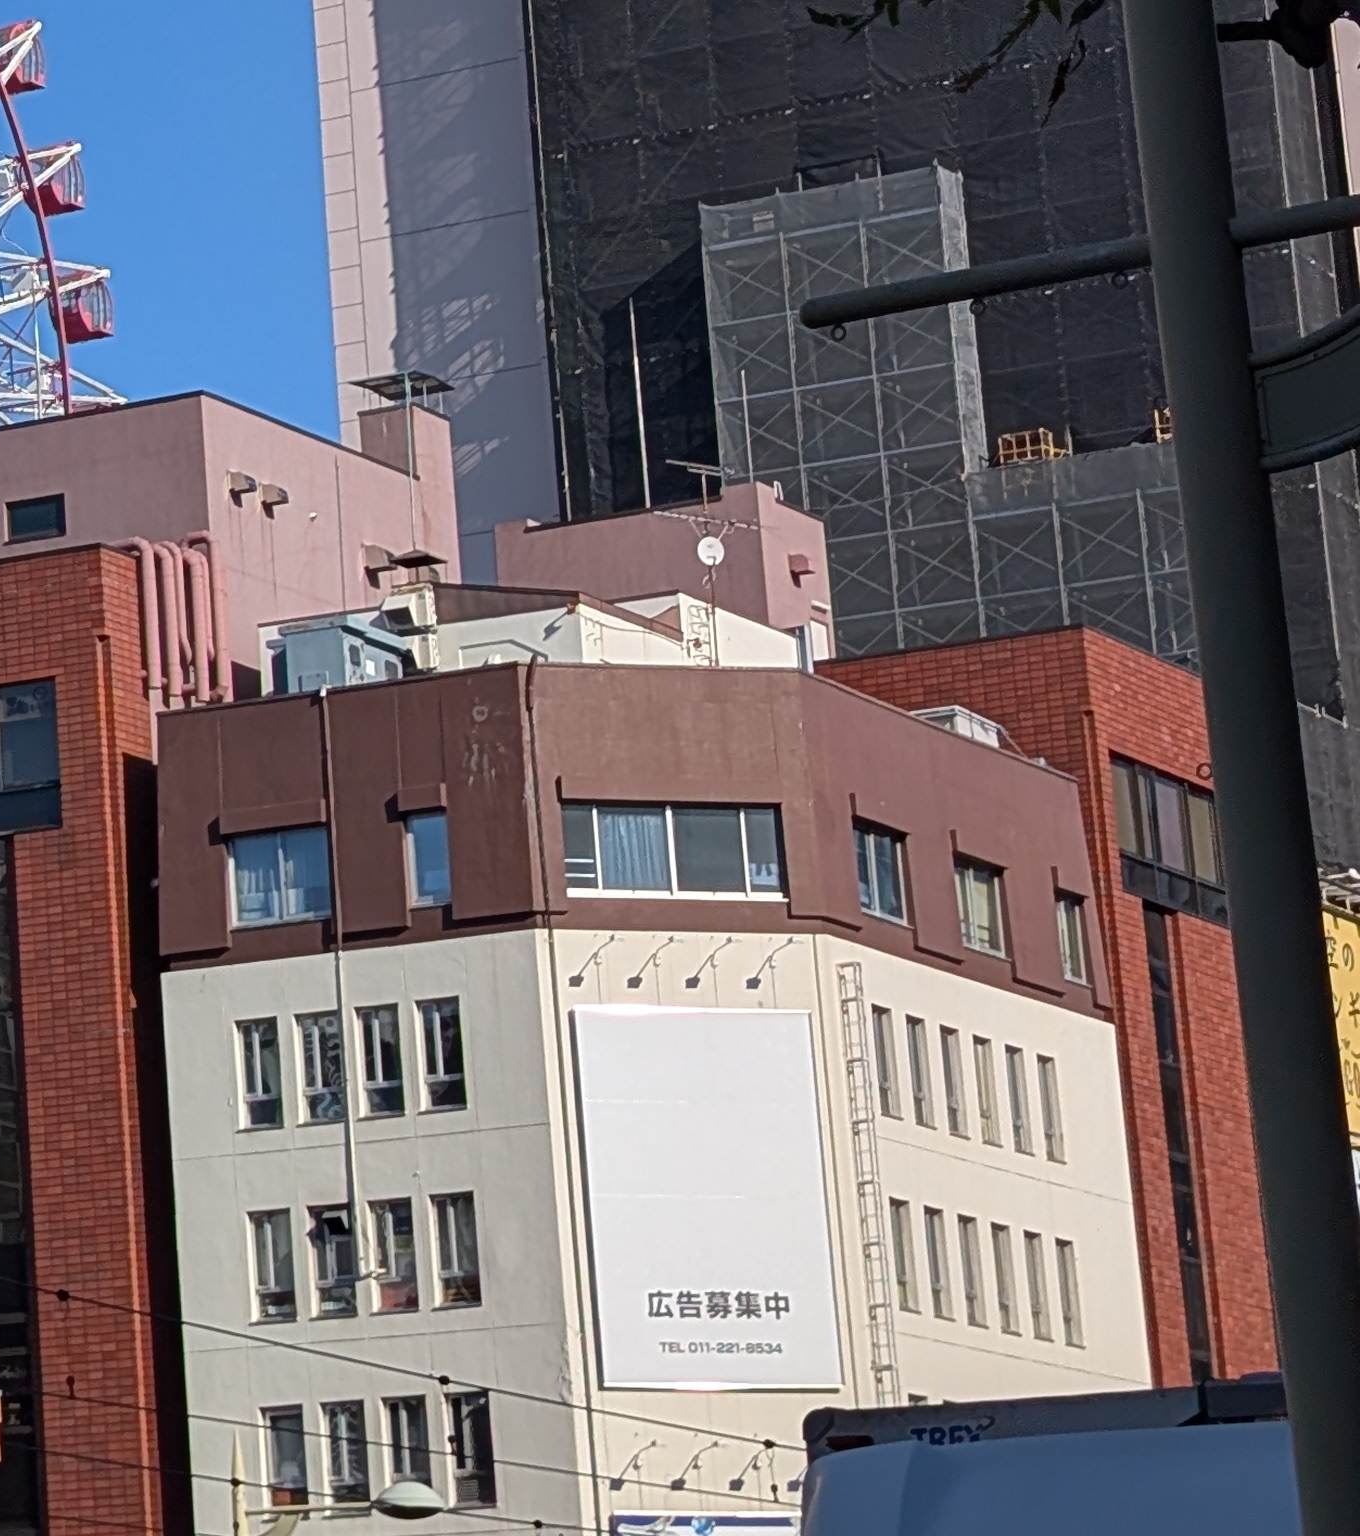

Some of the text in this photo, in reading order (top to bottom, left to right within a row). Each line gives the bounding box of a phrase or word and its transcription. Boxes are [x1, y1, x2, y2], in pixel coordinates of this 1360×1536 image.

[647, 1290, 791, 1320] 広告募集中
[659, 1341, 685, 1354] TEL
